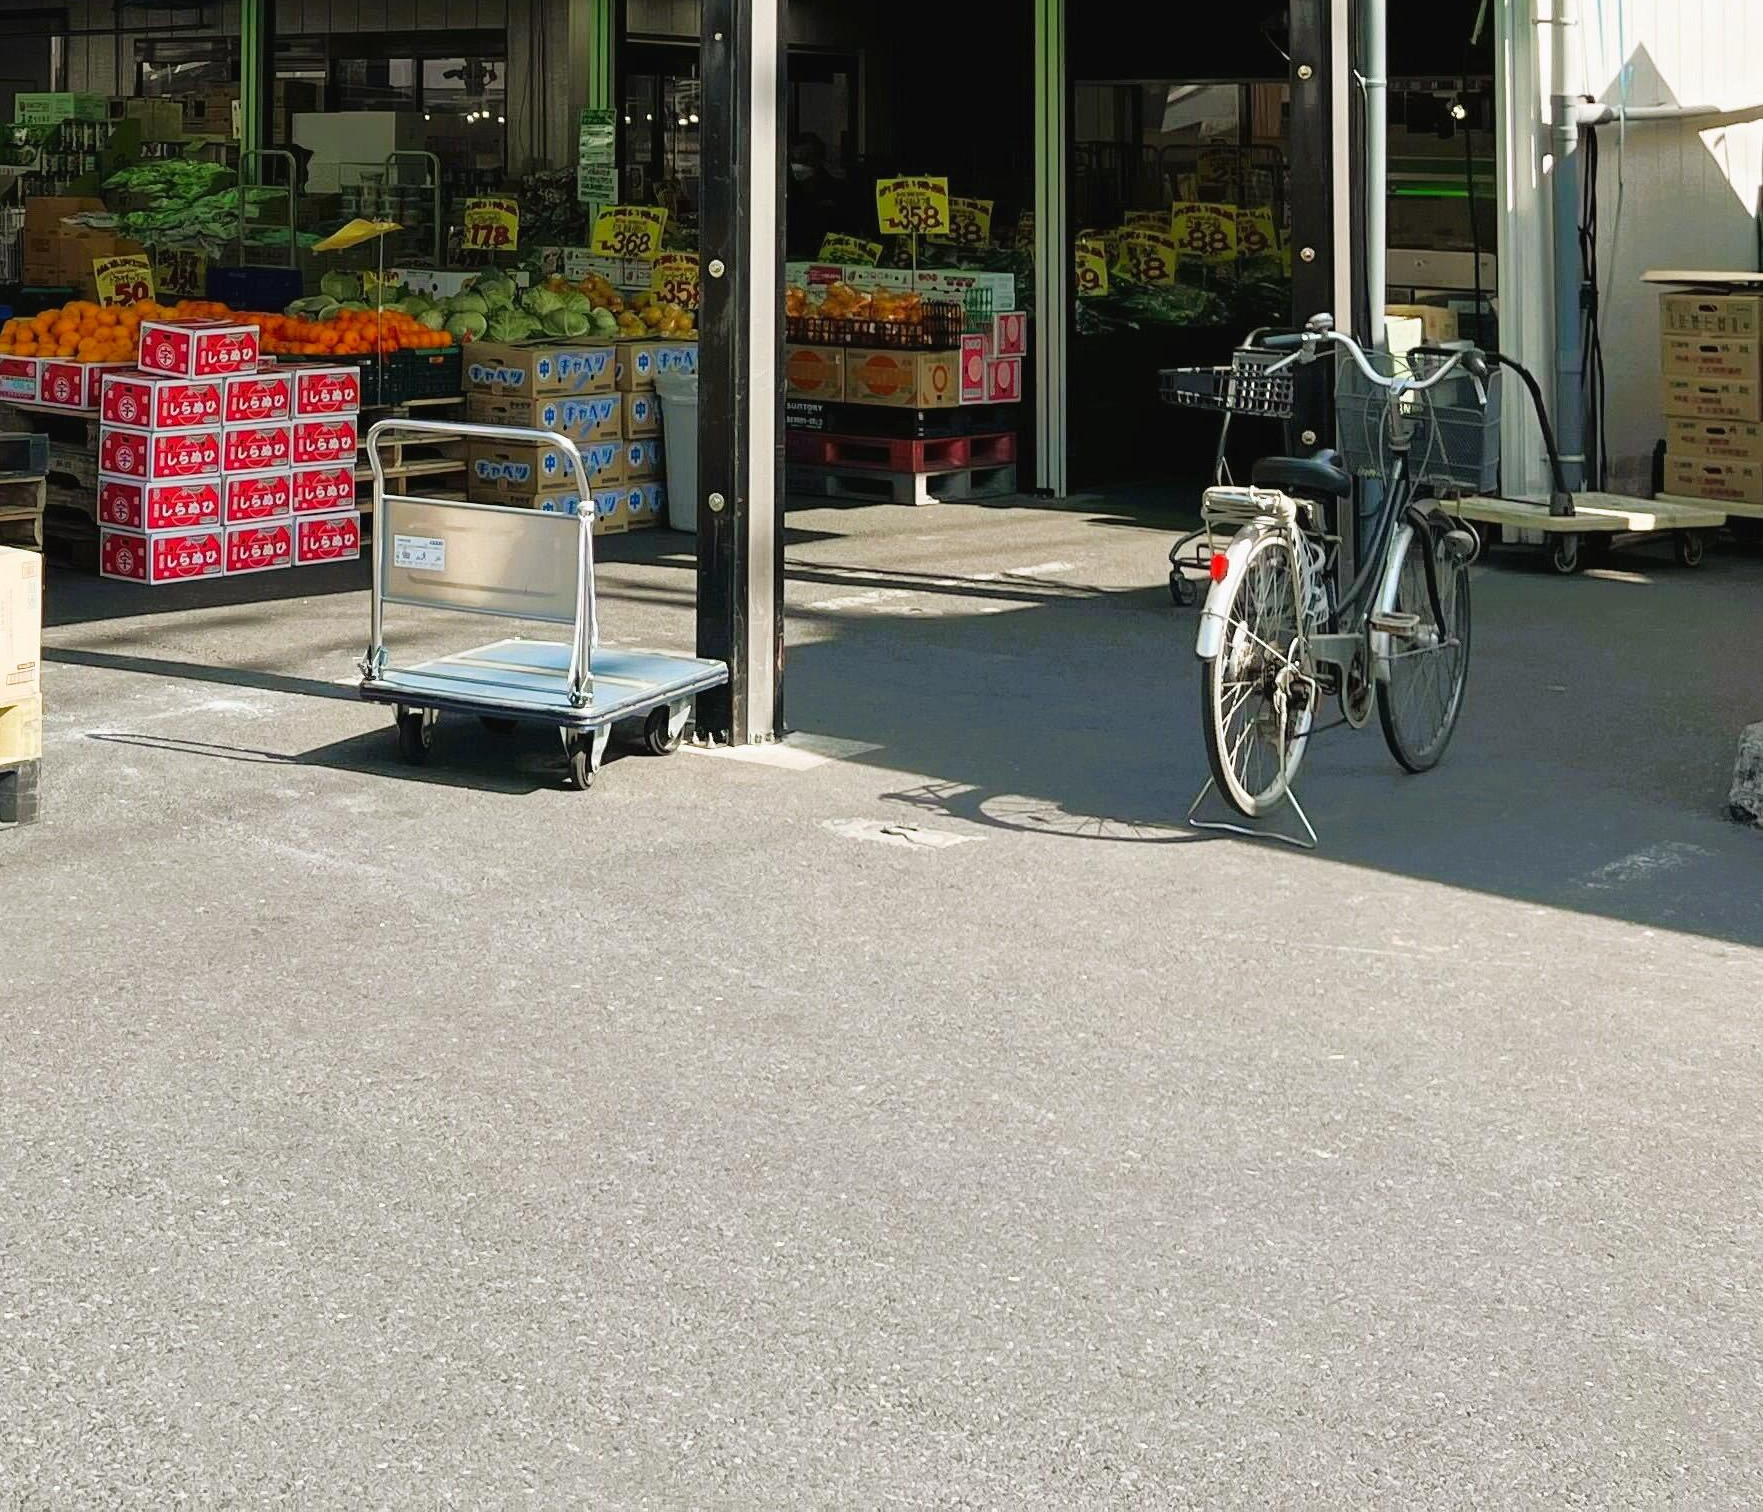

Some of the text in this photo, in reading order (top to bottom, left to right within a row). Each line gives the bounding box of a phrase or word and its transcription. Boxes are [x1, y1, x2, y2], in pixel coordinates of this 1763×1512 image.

[898, 205, 941, 230] 358
[613, 231, 652, 255] 368
[207, 348, 254, 364] しらぬひ
[559, 352, 606, 375] キャベツ
[658, 351, 698, 372] キャベ
[469, 365, 525, 385] キャベツ
[238, 395, 285, 410] しらぬひ
[309, 388, 355, 403] しらぬひ
[169, 400, 218, 416] しらぬひ
[564, 399, 612, 421] キャベツ
[237, 444, 285, 460] しらぬひ
[305, 437, 352, 452] しらぬひ
[167, 450, 216, 467] しらぬひ
[475, 462, 530, 481] キャベツ
[304, 484, 350, 500] しらぬひ
[161, 501, 215, 518] しらぬひ
[239, 492, 286, 510] しらぬひ
[565, 494, 616, 516] キベツ
[309, 534, 355, 550] しらぬひ
[167, 551, 218, 568] しらぬひ
[239, 542, 287, 560] しらぬひ
